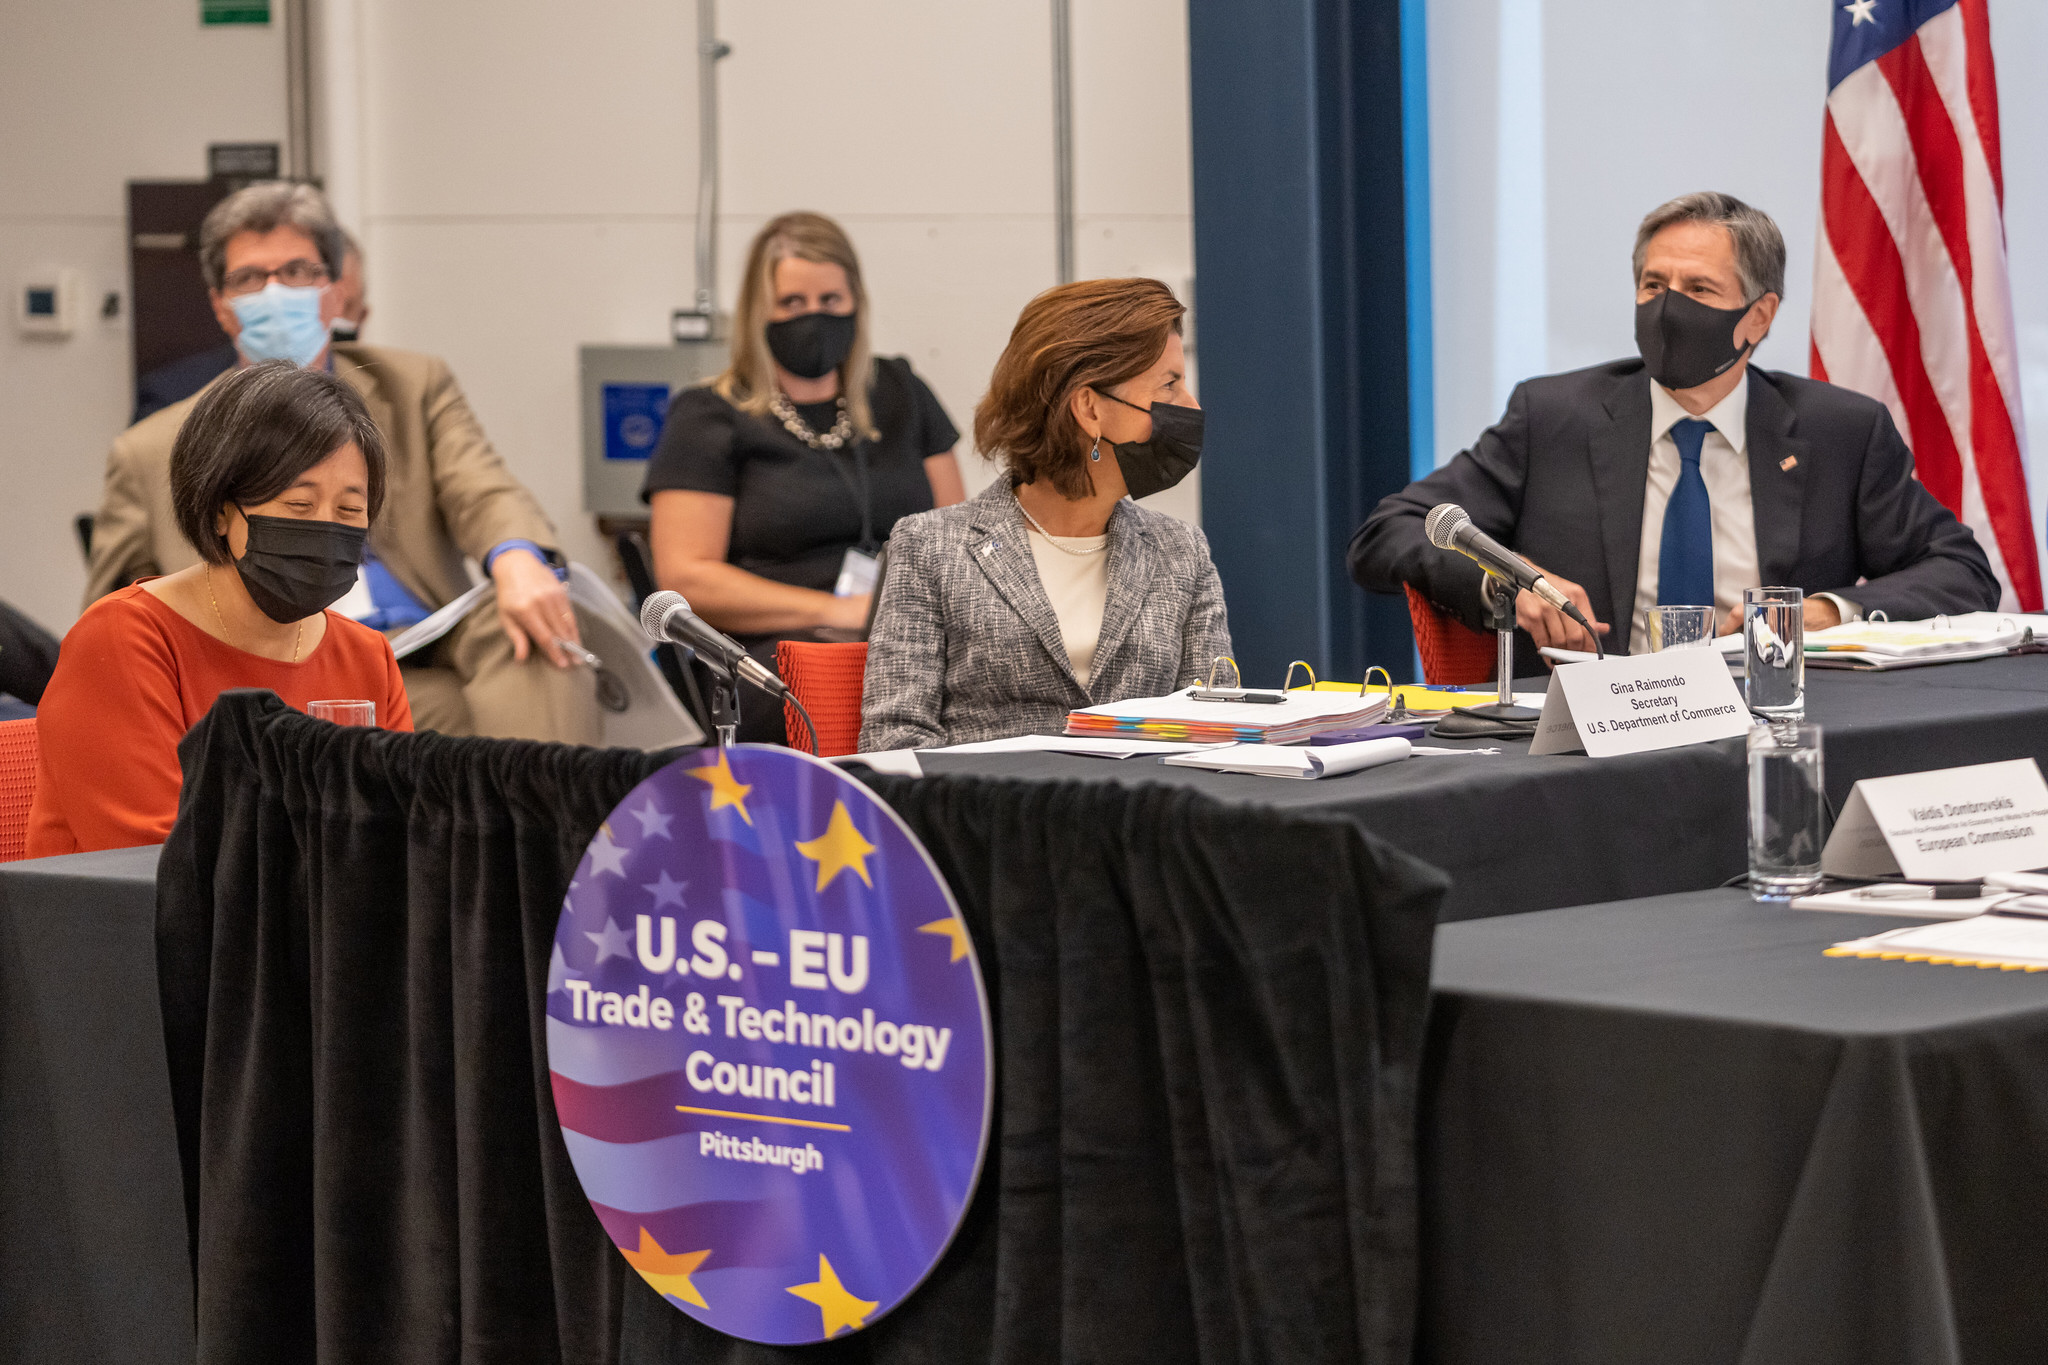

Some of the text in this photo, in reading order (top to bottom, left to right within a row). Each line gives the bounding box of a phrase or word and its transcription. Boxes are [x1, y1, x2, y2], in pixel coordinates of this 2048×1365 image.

[1610, 675, 1686, 695] Gina Raimondo
[1630, 695, 1679, 710] Secretary
[1586, 703, 1737, 735] U.S. Department of Commerce
[1908, 806, 1944, 821] Valdis
[1944, 797, 2014, 817] Dombrovskis
[1916, 826, 2035, 852] European Commission
[635, 913, 743, 981] U.S.
[789, 928, 870, 994] EU
[564, 978, 952, 1072] Trade & Technology
[684, 1049, 836, 1108] Council
[699, 1130, 824, 1175] Pittsburgh
